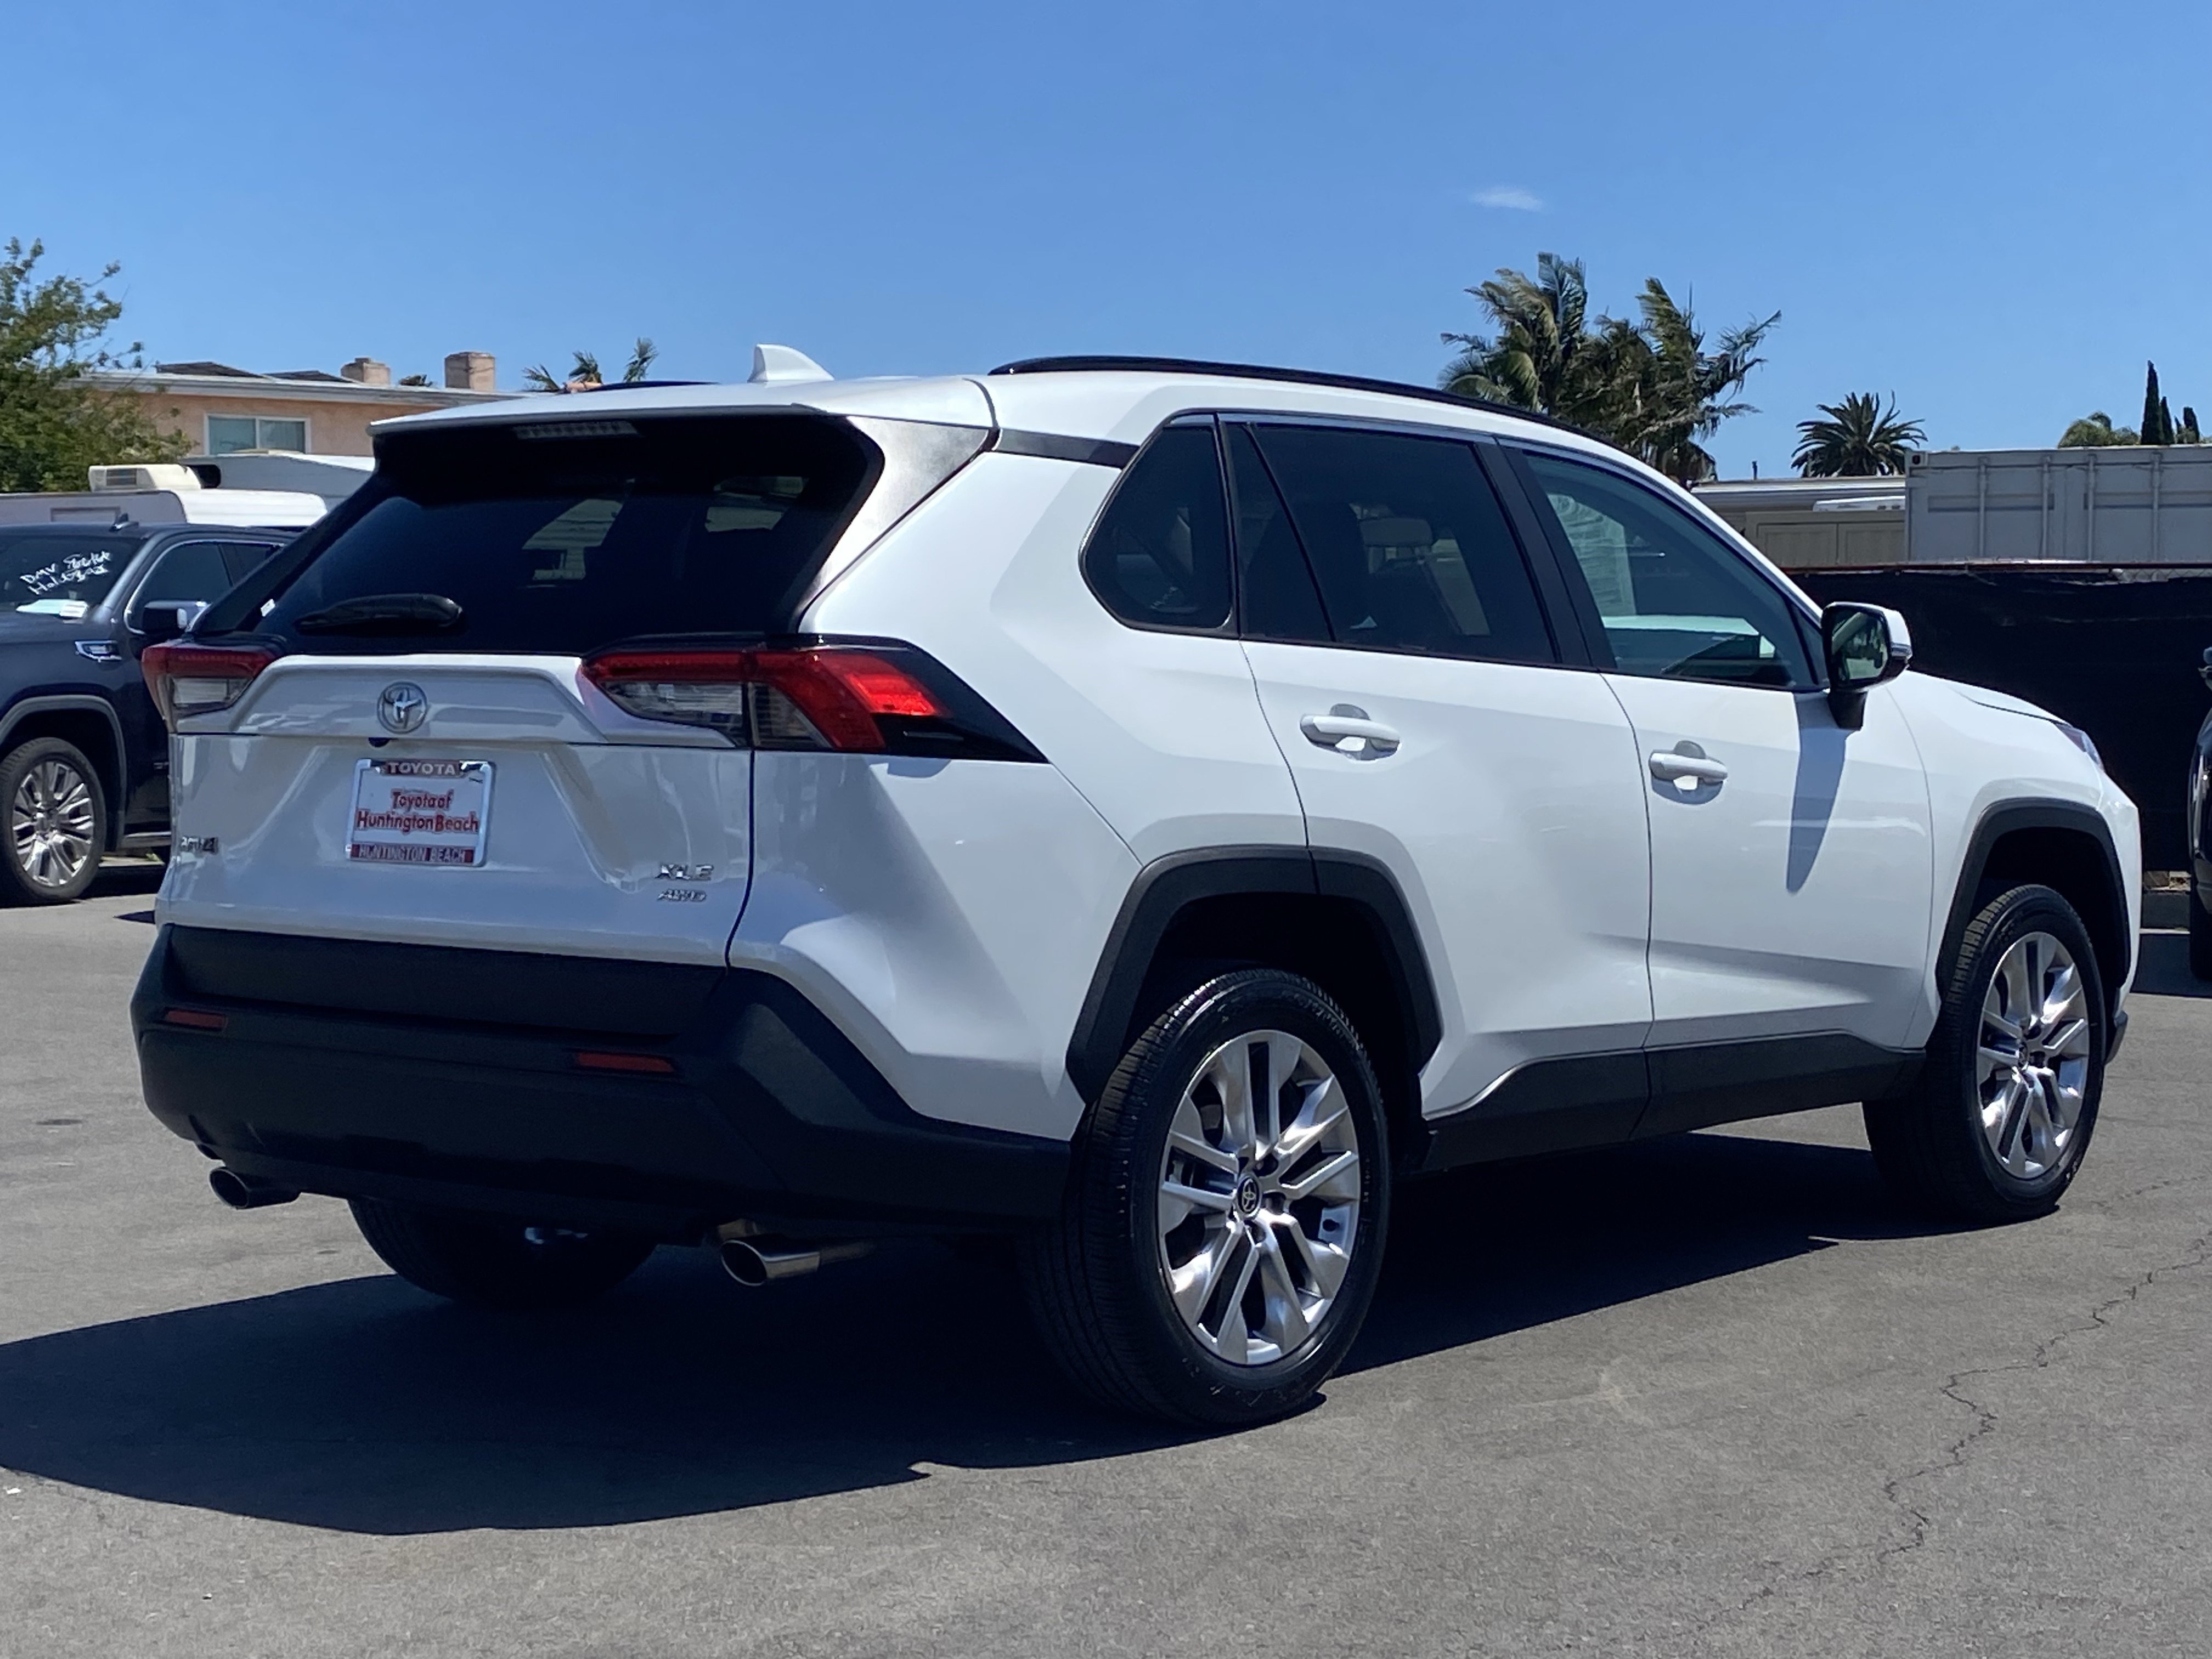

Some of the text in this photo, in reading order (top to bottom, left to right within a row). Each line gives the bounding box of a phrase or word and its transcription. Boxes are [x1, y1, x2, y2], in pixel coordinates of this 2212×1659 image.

[387, 761, 455, 775] TOYOTA
[358, 844, 465, 863] HUNTINGTON BEACH
